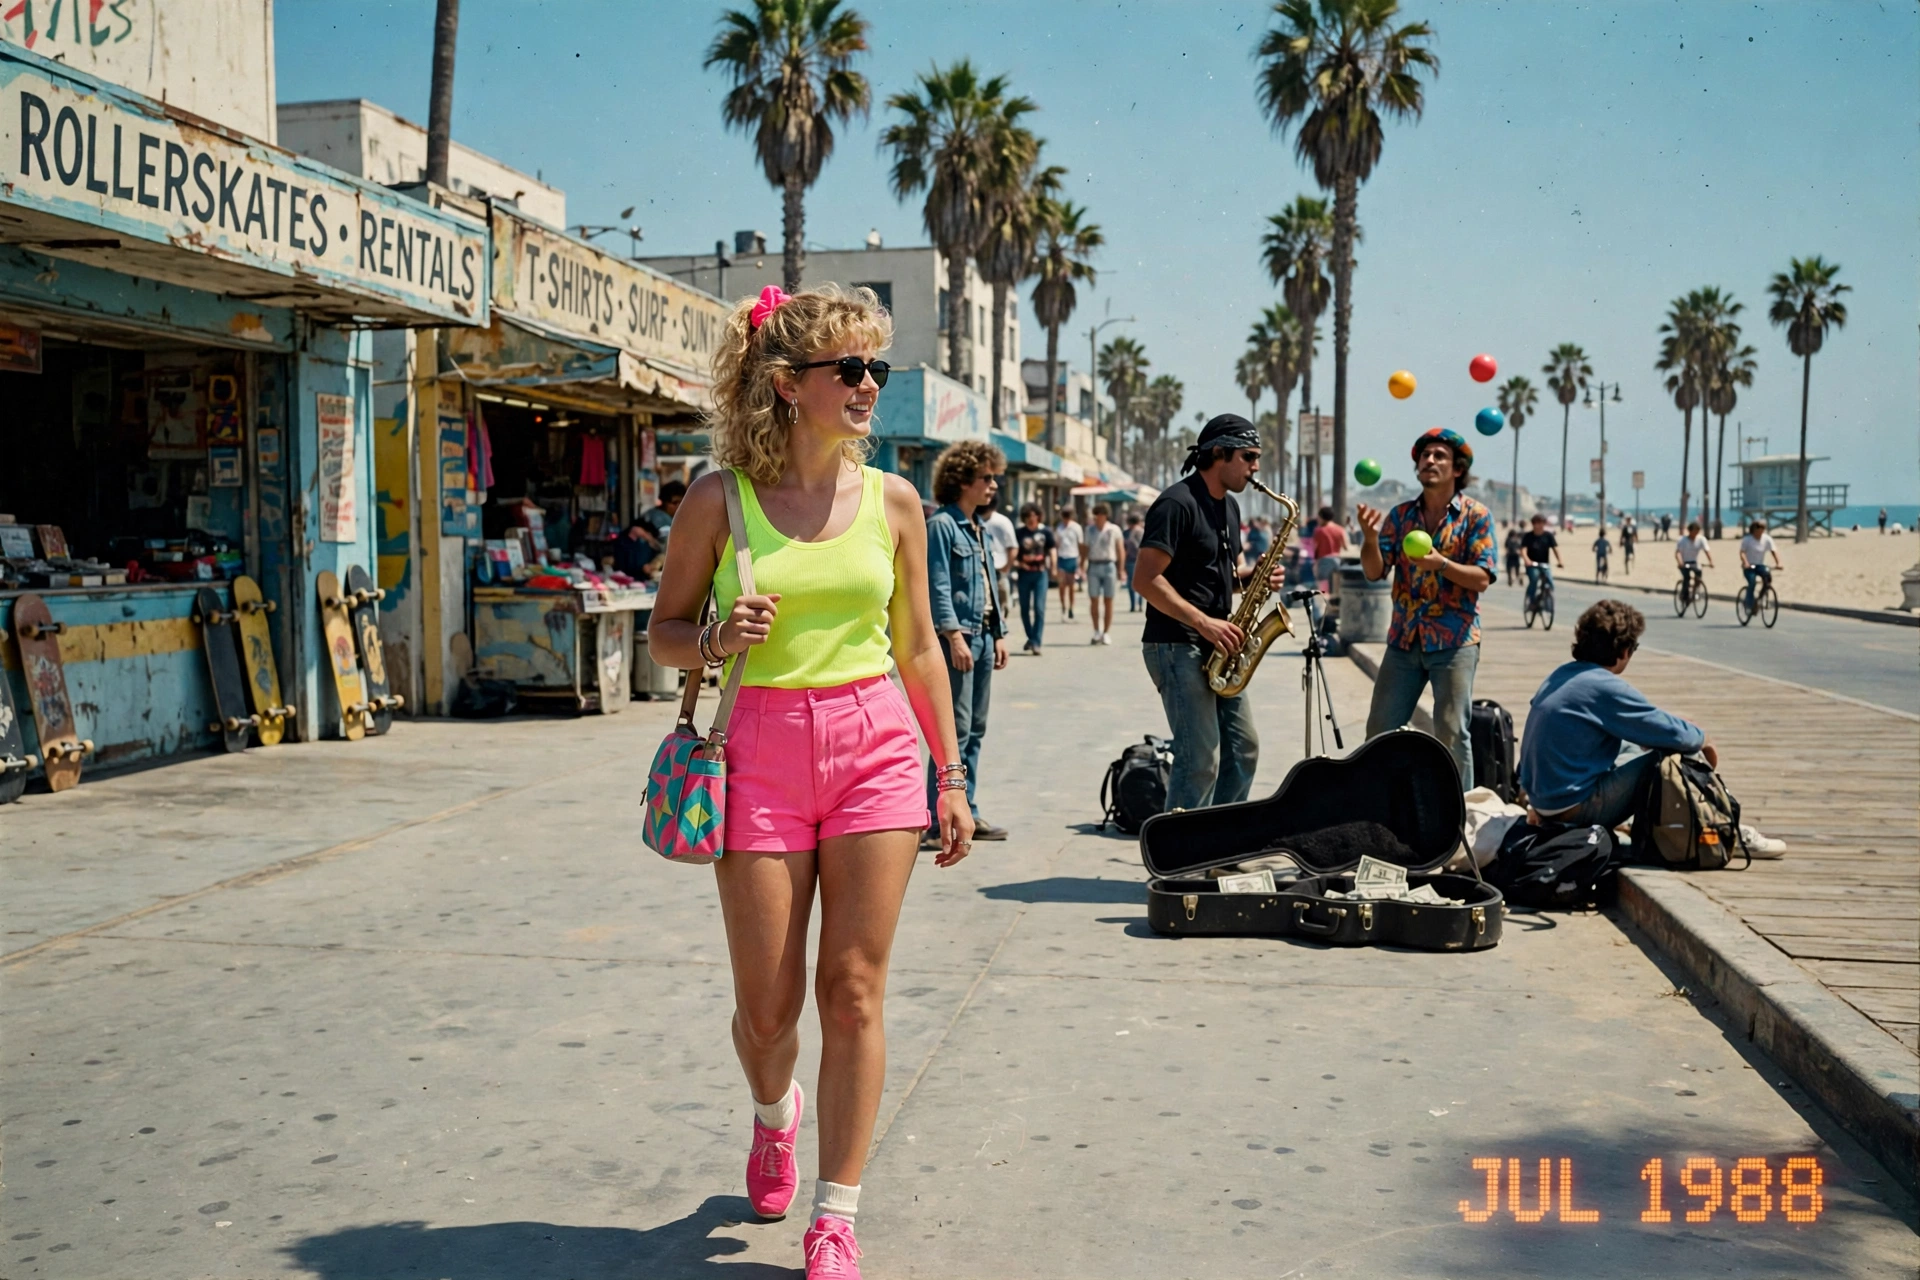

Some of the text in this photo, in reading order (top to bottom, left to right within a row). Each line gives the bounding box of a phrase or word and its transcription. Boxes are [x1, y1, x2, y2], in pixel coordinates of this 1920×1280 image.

[19, 91, 475, 301] ROLLERSKATES RENTALS
[628, 283, 669, 342] SURF
